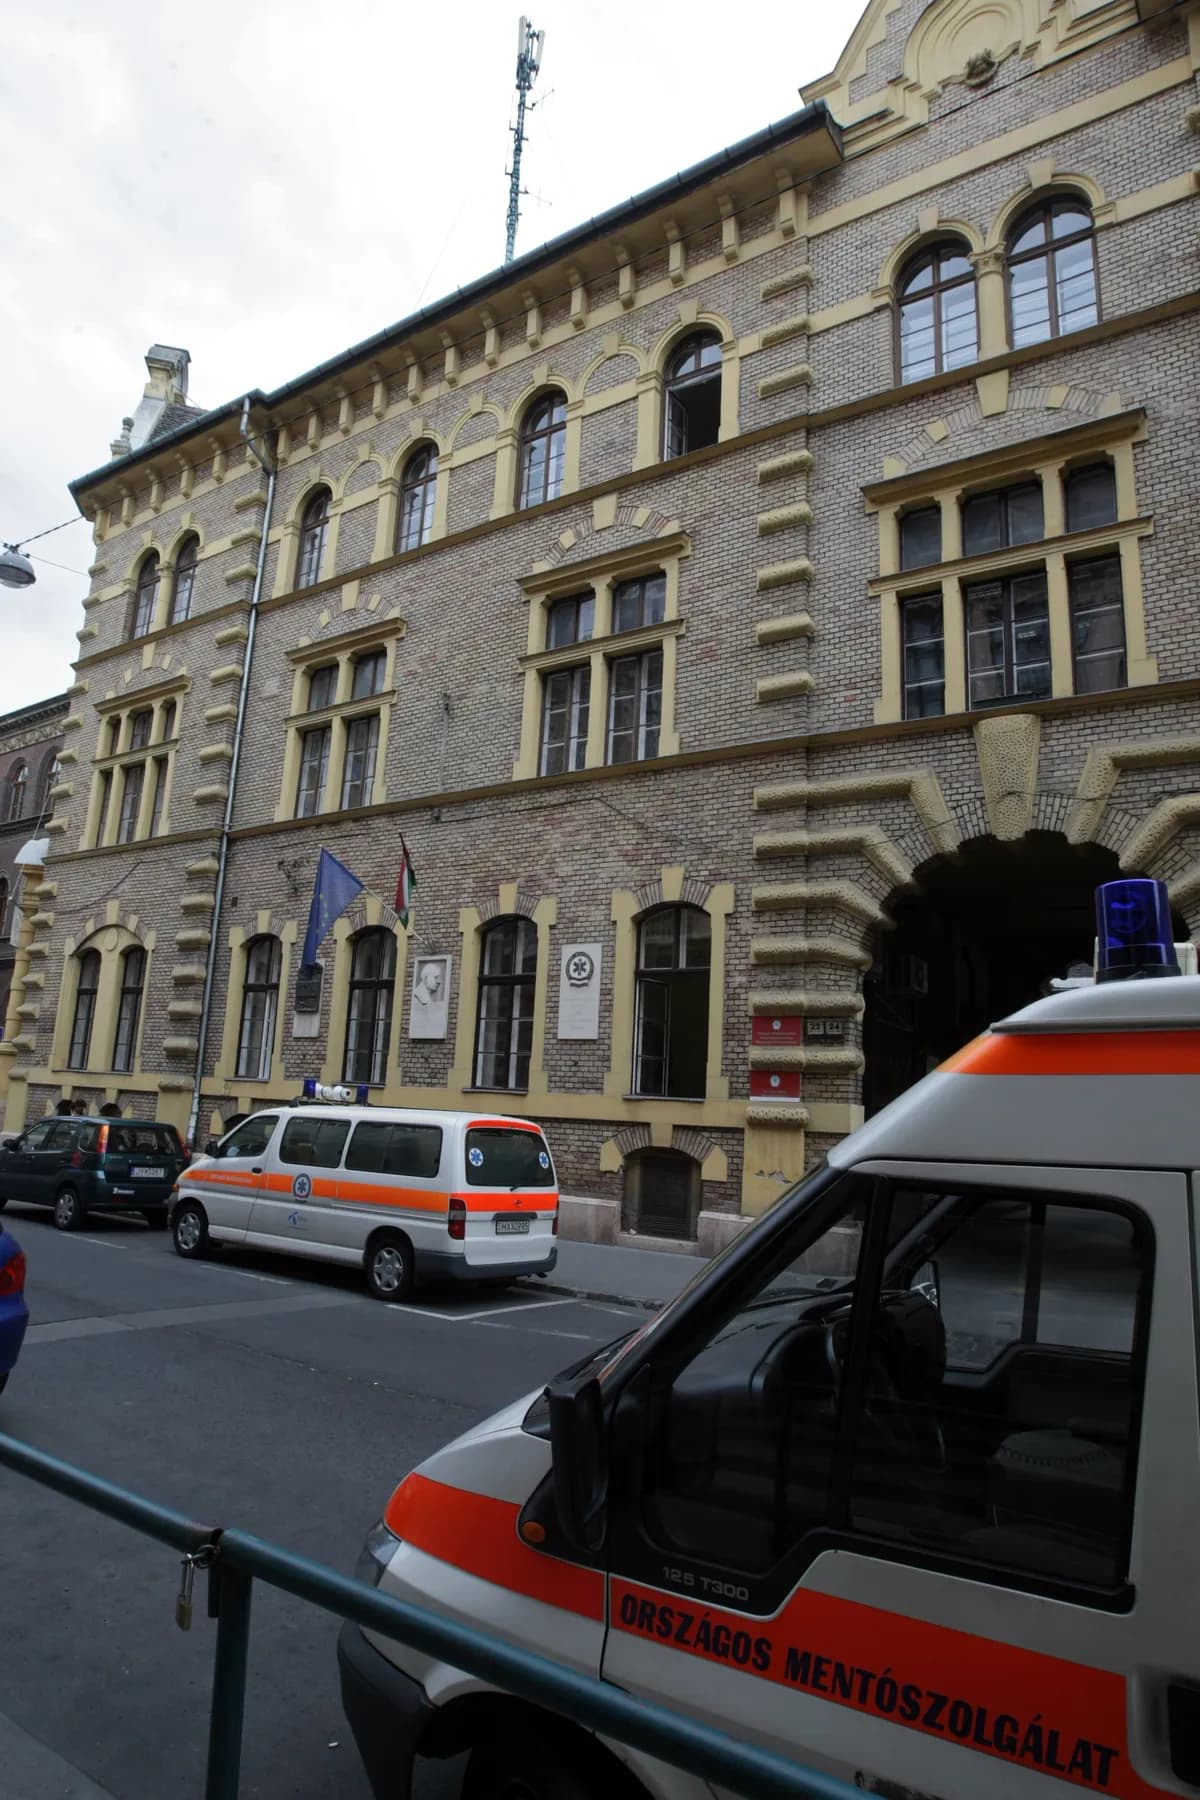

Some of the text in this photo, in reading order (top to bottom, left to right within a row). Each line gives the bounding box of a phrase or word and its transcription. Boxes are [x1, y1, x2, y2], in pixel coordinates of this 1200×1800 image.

[663, 1566, 750, 1601] 125 T300
[620, 1594, 772, 1672] ORSZÁGOS
